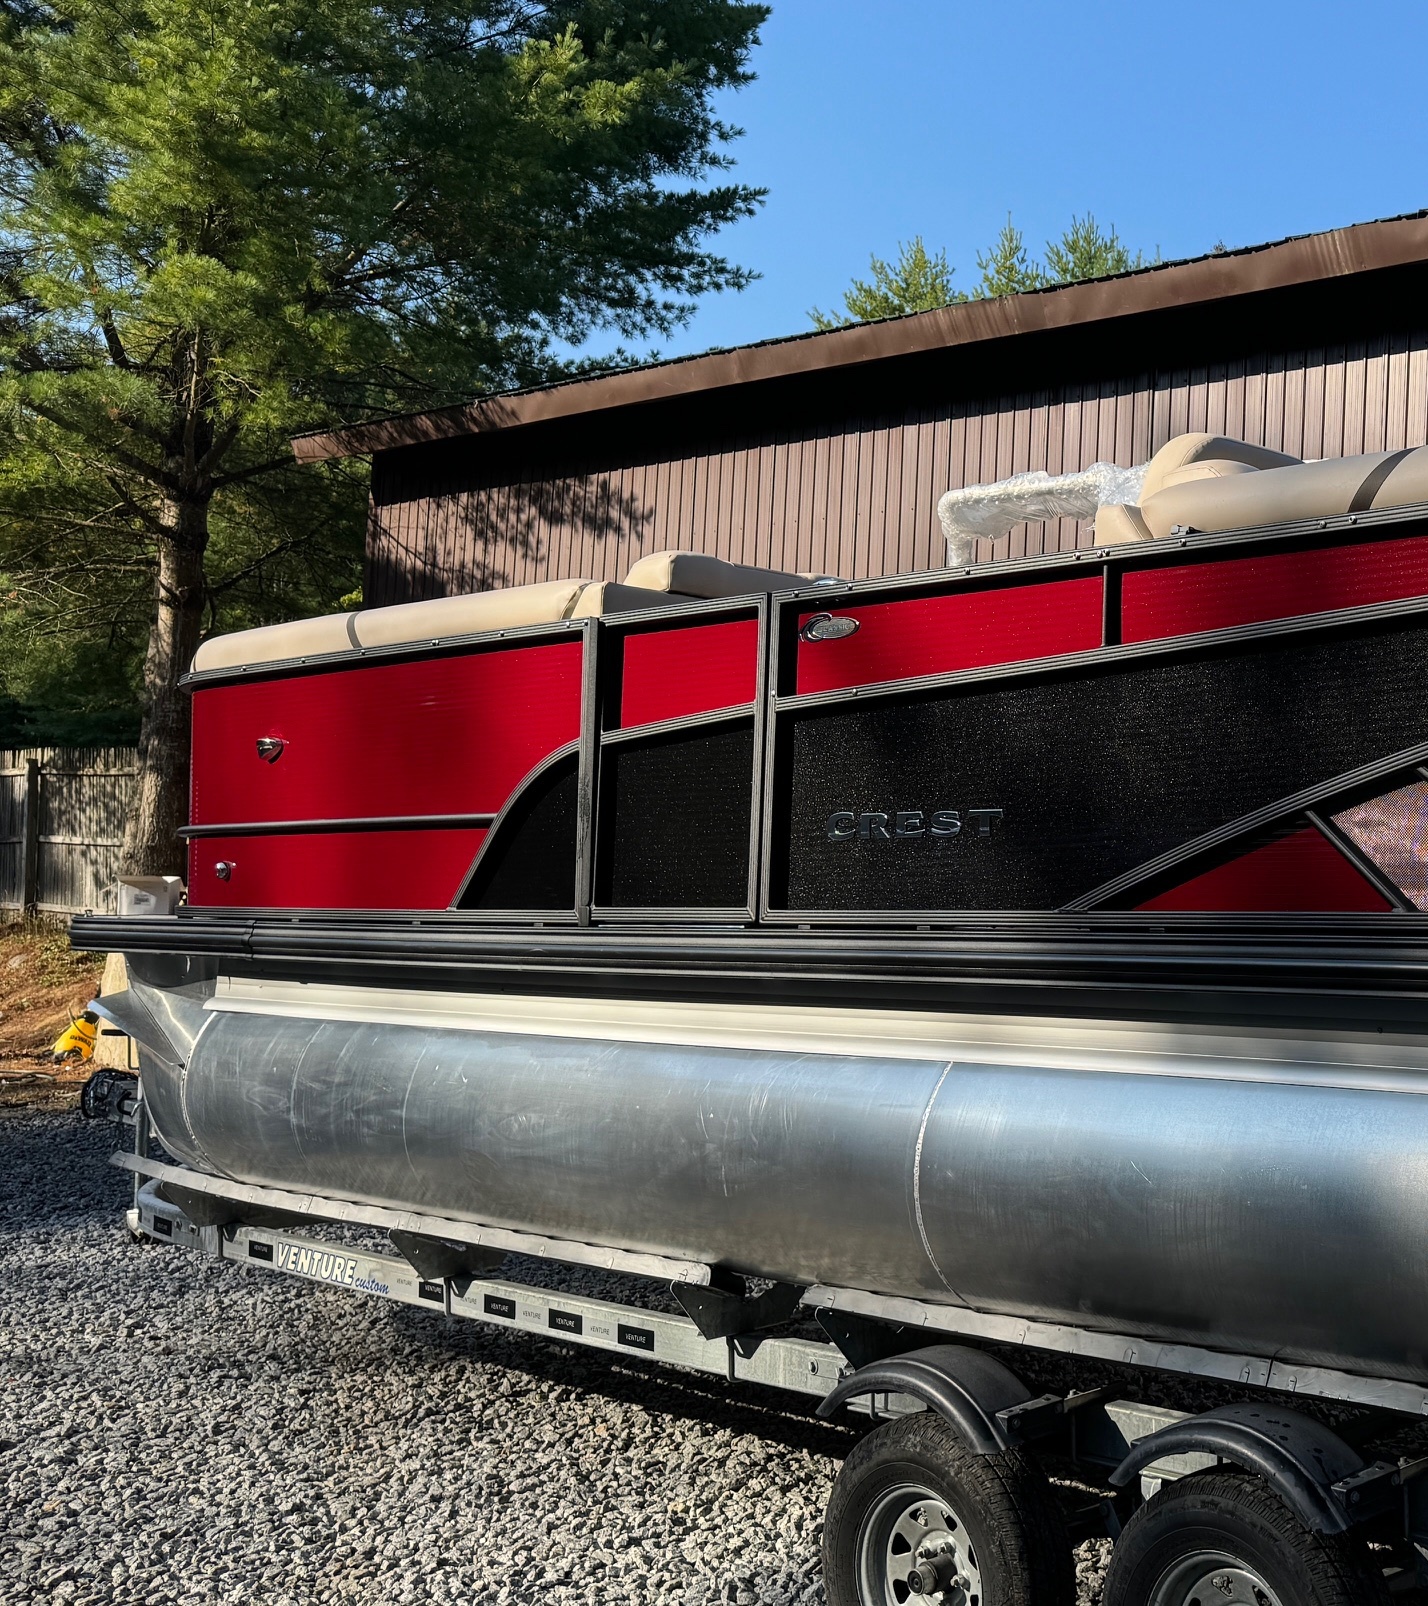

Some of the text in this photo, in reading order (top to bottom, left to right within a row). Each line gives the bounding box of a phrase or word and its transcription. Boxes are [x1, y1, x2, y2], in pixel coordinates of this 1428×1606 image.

[826, 808, 1004, 841] CREST
[277, 1242, 390, 1295] VENTURE custom
[425, 1284, 442, 1294] VENTURE
[490, 1303, 509, 1312] VENTURE
[522, 1310, 541, 1319] VENTURE
[555, 1317, 575, 1328] VENTURE
[590, 1326, 610, 1335] VENTURE
[625, 1333, 647, 1343] VENTURE
